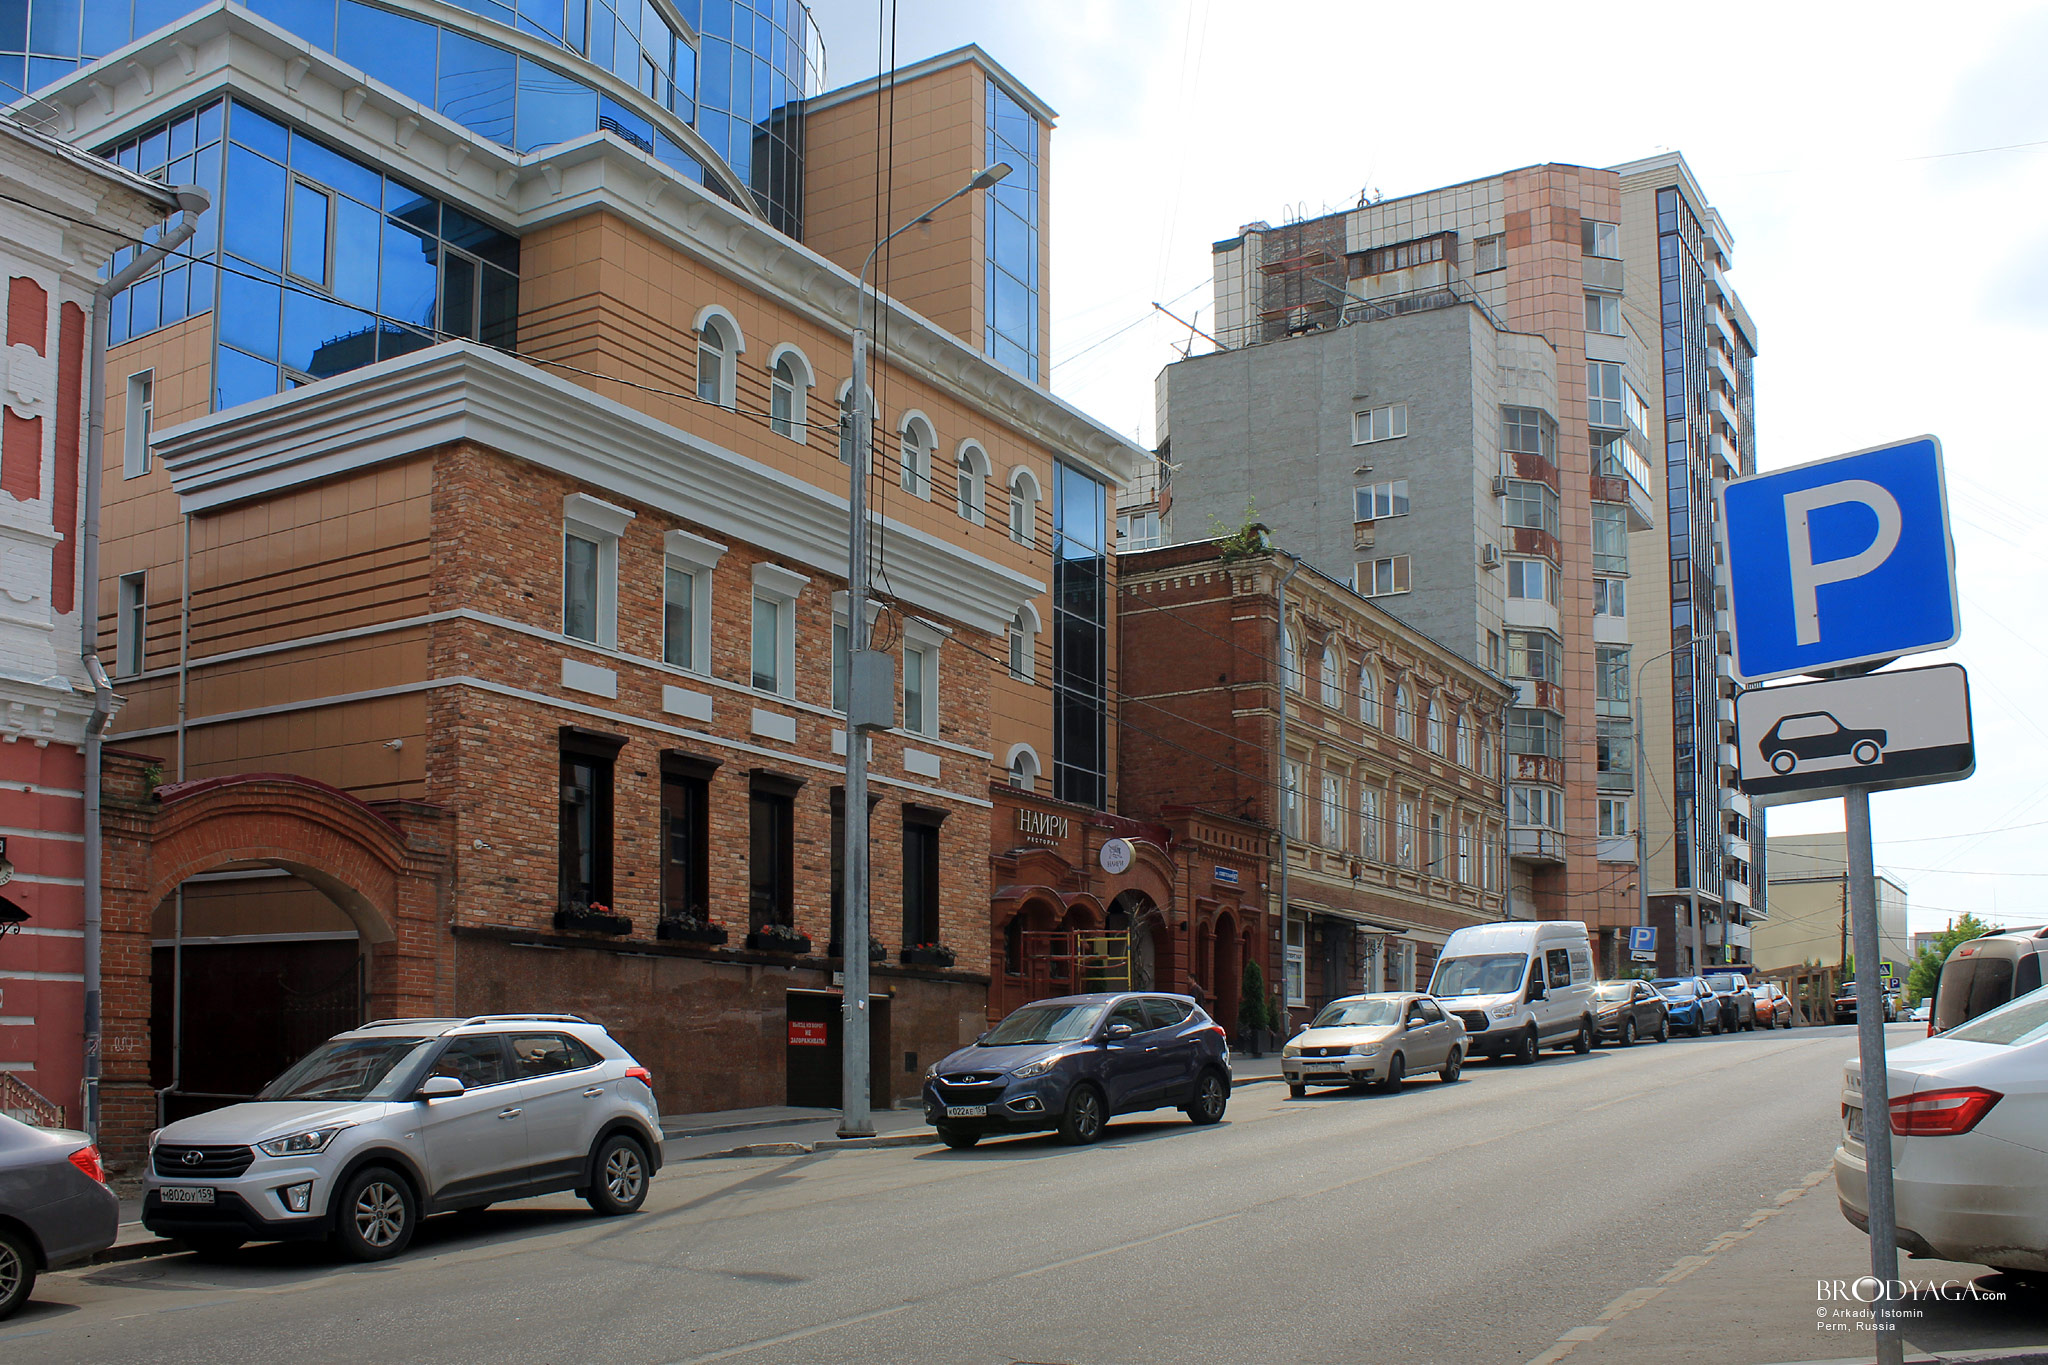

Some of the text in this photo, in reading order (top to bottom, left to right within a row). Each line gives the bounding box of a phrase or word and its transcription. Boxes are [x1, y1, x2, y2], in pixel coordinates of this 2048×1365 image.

[1783, 479, 1903, 646] P
[1020, 808, 1068, 839] НАИРИ
[1027, 836, 1059, 846] РЕСТОРАН
[1634, 929, 1652, 949] P
[804, 1029, 812, 1037] НЕ
[198, 1188, 212, 1199] 159
